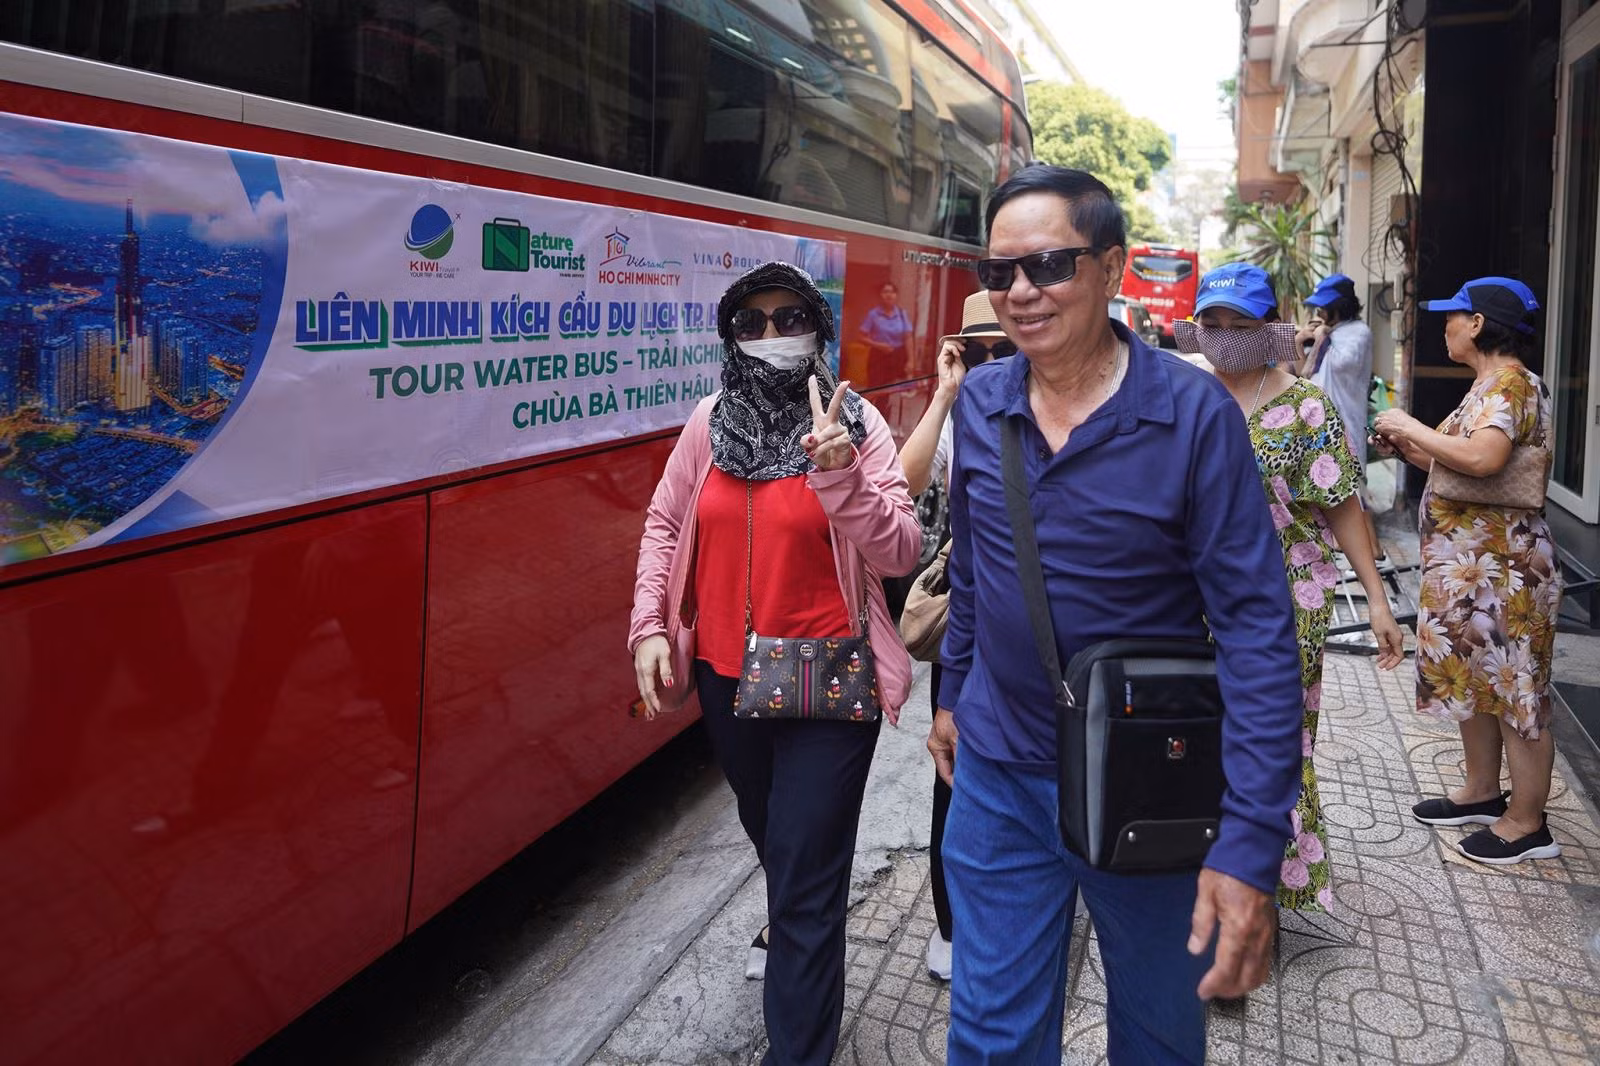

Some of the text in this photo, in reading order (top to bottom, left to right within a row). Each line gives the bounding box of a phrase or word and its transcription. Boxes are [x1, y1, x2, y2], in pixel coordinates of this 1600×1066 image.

[410, 261, 439, 271] KIWI
[531, 249, 585, 271] Tourist
[618, 254, 682, 269] Vibrant
[1209, 277, 1236, 289] KIWI
[295, 291, 386, 349] LIÊN
[393, 300, 481, 345] MINH
[490, 293, 550, 340] KÍCH
[558, 290, 601, 336] CẦU
[608, 301, 637, 335] DU
[641, 301, 679, 339] LỊCH
[683, 302, 704, 331] TP.
[369, 362, 465, 399] TOUR
[473, 354, 568, 388] WATER
[574, 350, 618, 378] BUS
[637, 341, 678, 371] TRẢI
[512, 373, 713, 429] CHÙA BÀ THIÊN HẬU
